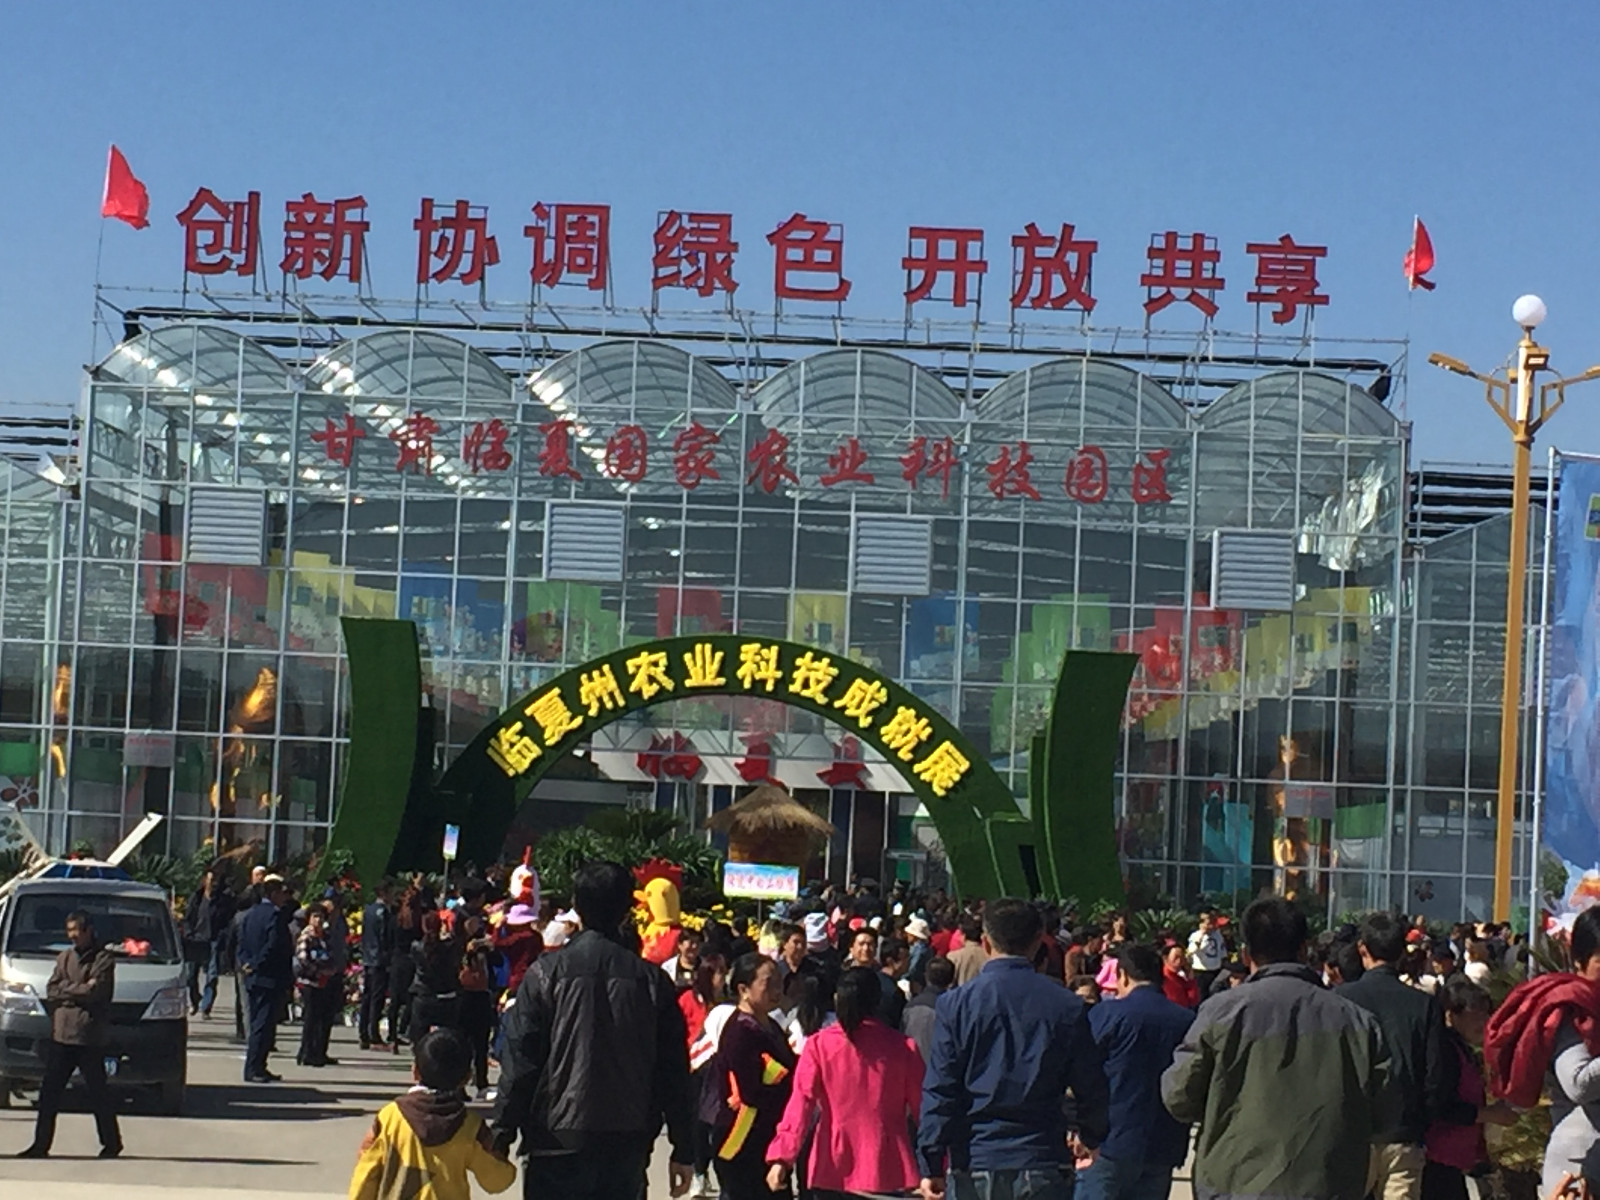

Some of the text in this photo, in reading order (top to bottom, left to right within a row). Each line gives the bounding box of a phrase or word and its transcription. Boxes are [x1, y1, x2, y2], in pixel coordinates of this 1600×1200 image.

[312, 411, 1176, 504] 甘肃临夏国家农业科技园区
[486, 642, 971, 798] 临夏州农业科技成就展
